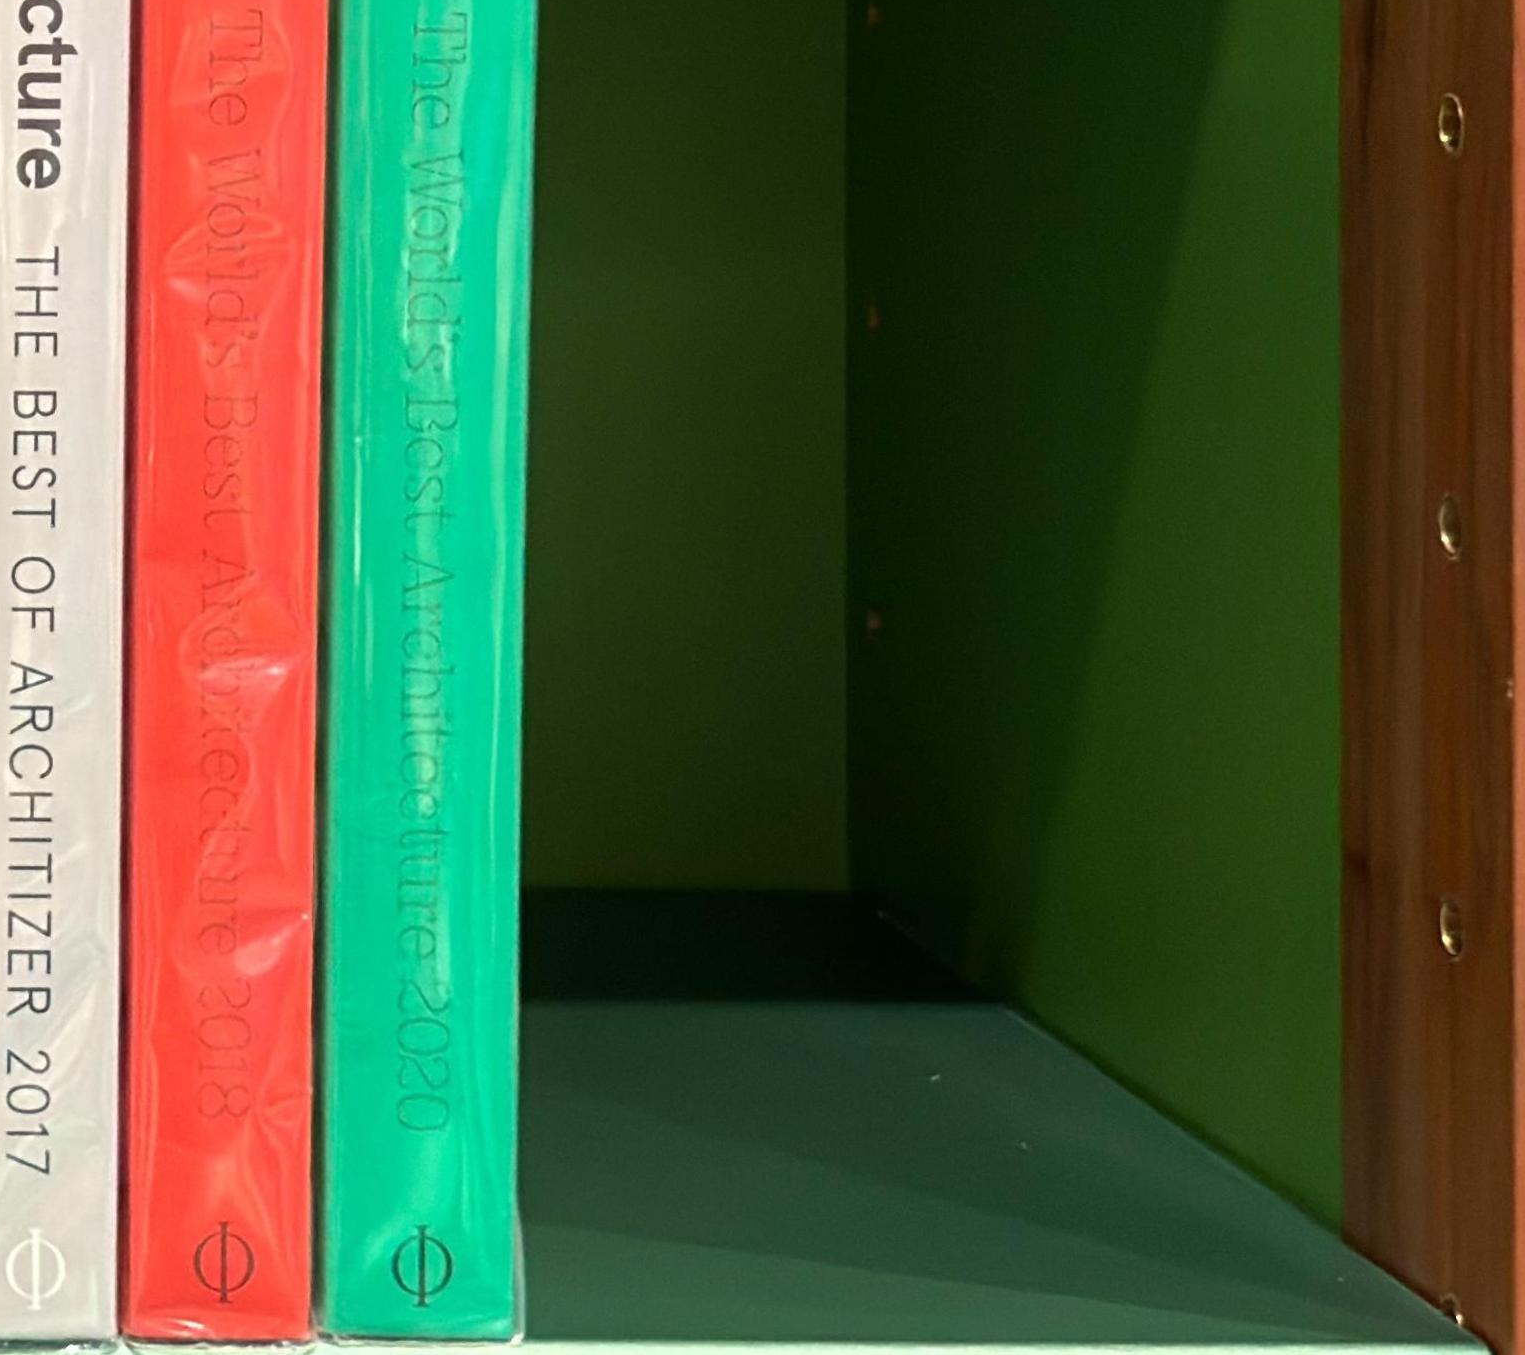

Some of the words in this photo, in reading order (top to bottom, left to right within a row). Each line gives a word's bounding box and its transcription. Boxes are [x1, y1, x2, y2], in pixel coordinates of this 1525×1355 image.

[208, 8, 264, 127] The
[410, 10, 469, 130] The
[13, 245, 60, 358] THE
[11, 389, 59, 529] BEST
[201, 391, 259, 530] Best
[401, 395, 460, 530] Best
[9, 555, 56, 633] OF
[197, 547, 256, 958] Architecture
[397, 551, 457, 961] Architecture
[5, 660, 55, 1019] ARCHITIZER
[4, 1049, 52, 1176] 2017
[196, 979, 253, 1122] 2018
[395, 981, 452, 1134] 2020
